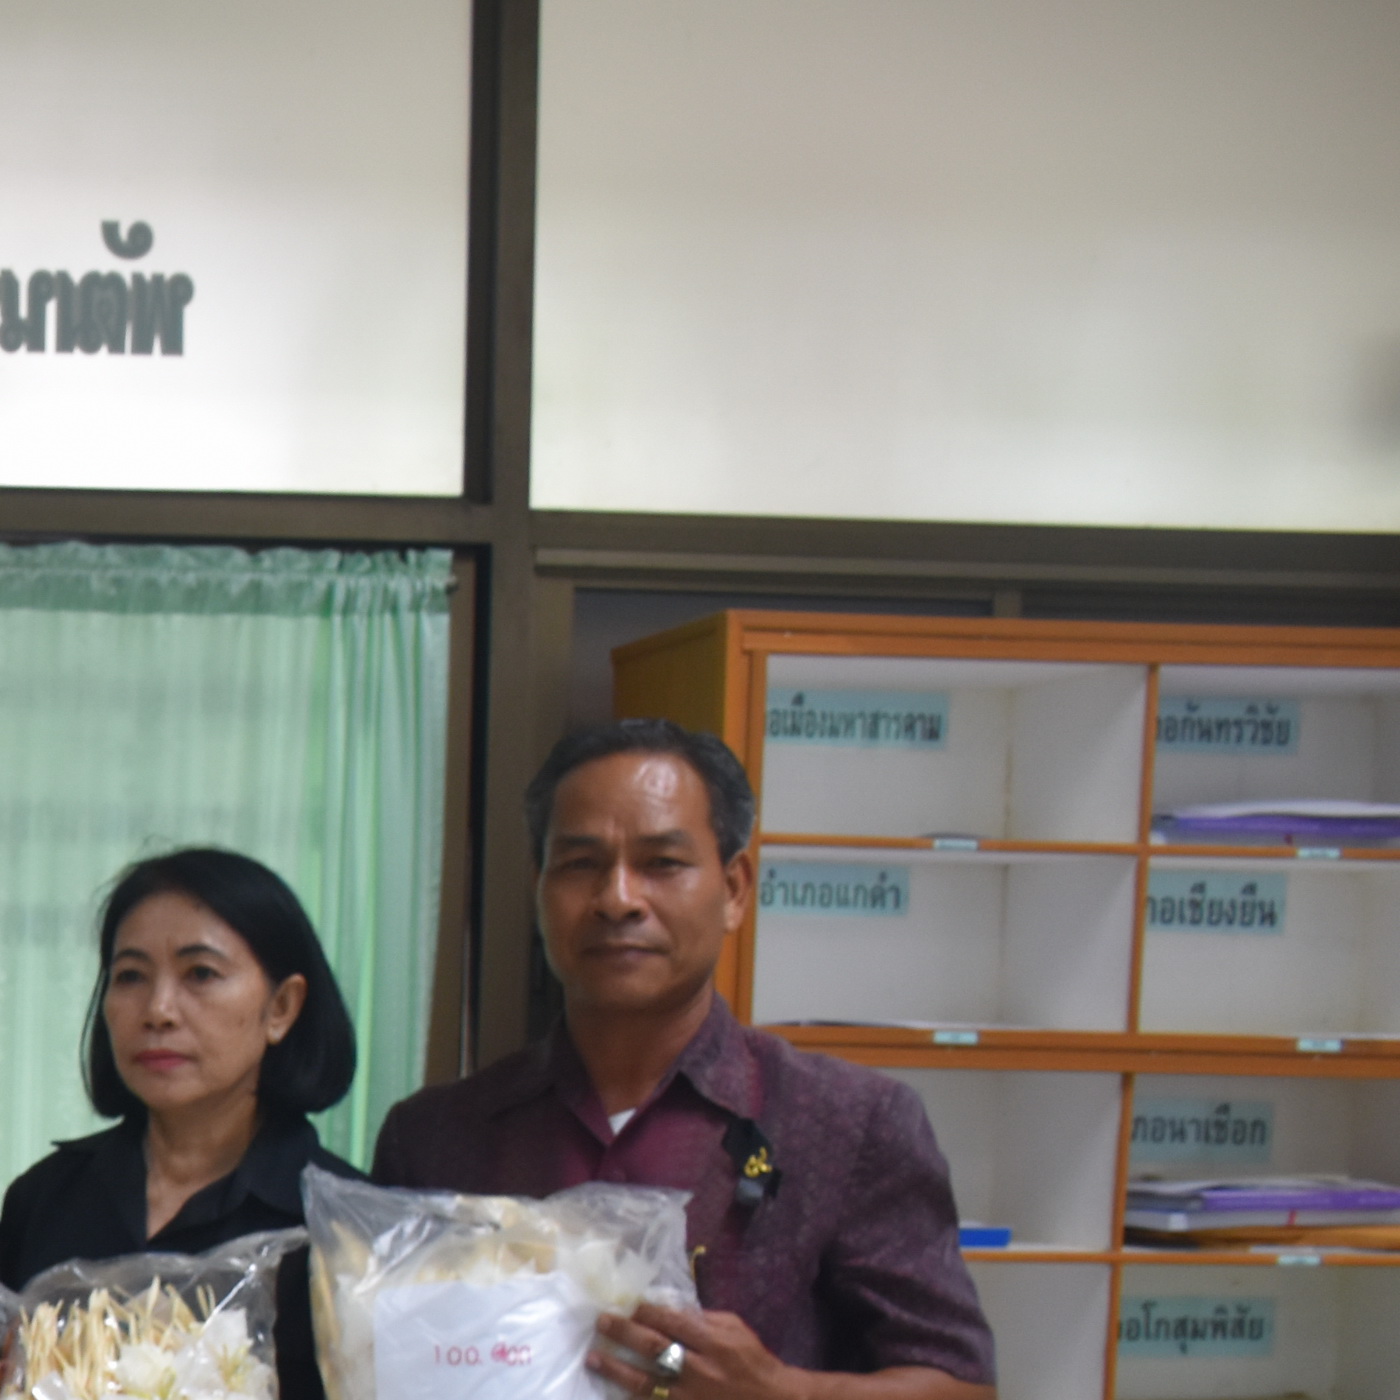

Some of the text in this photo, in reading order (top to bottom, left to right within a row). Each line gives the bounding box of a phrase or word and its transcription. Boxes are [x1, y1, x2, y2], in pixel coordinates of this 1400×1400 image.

[760, 868, 902, 910] อำเภอแกดำ
[1118, 1300, 1264, 1355] อโกสุมพิสัย
[433, 1344, 481, 1367] 100
